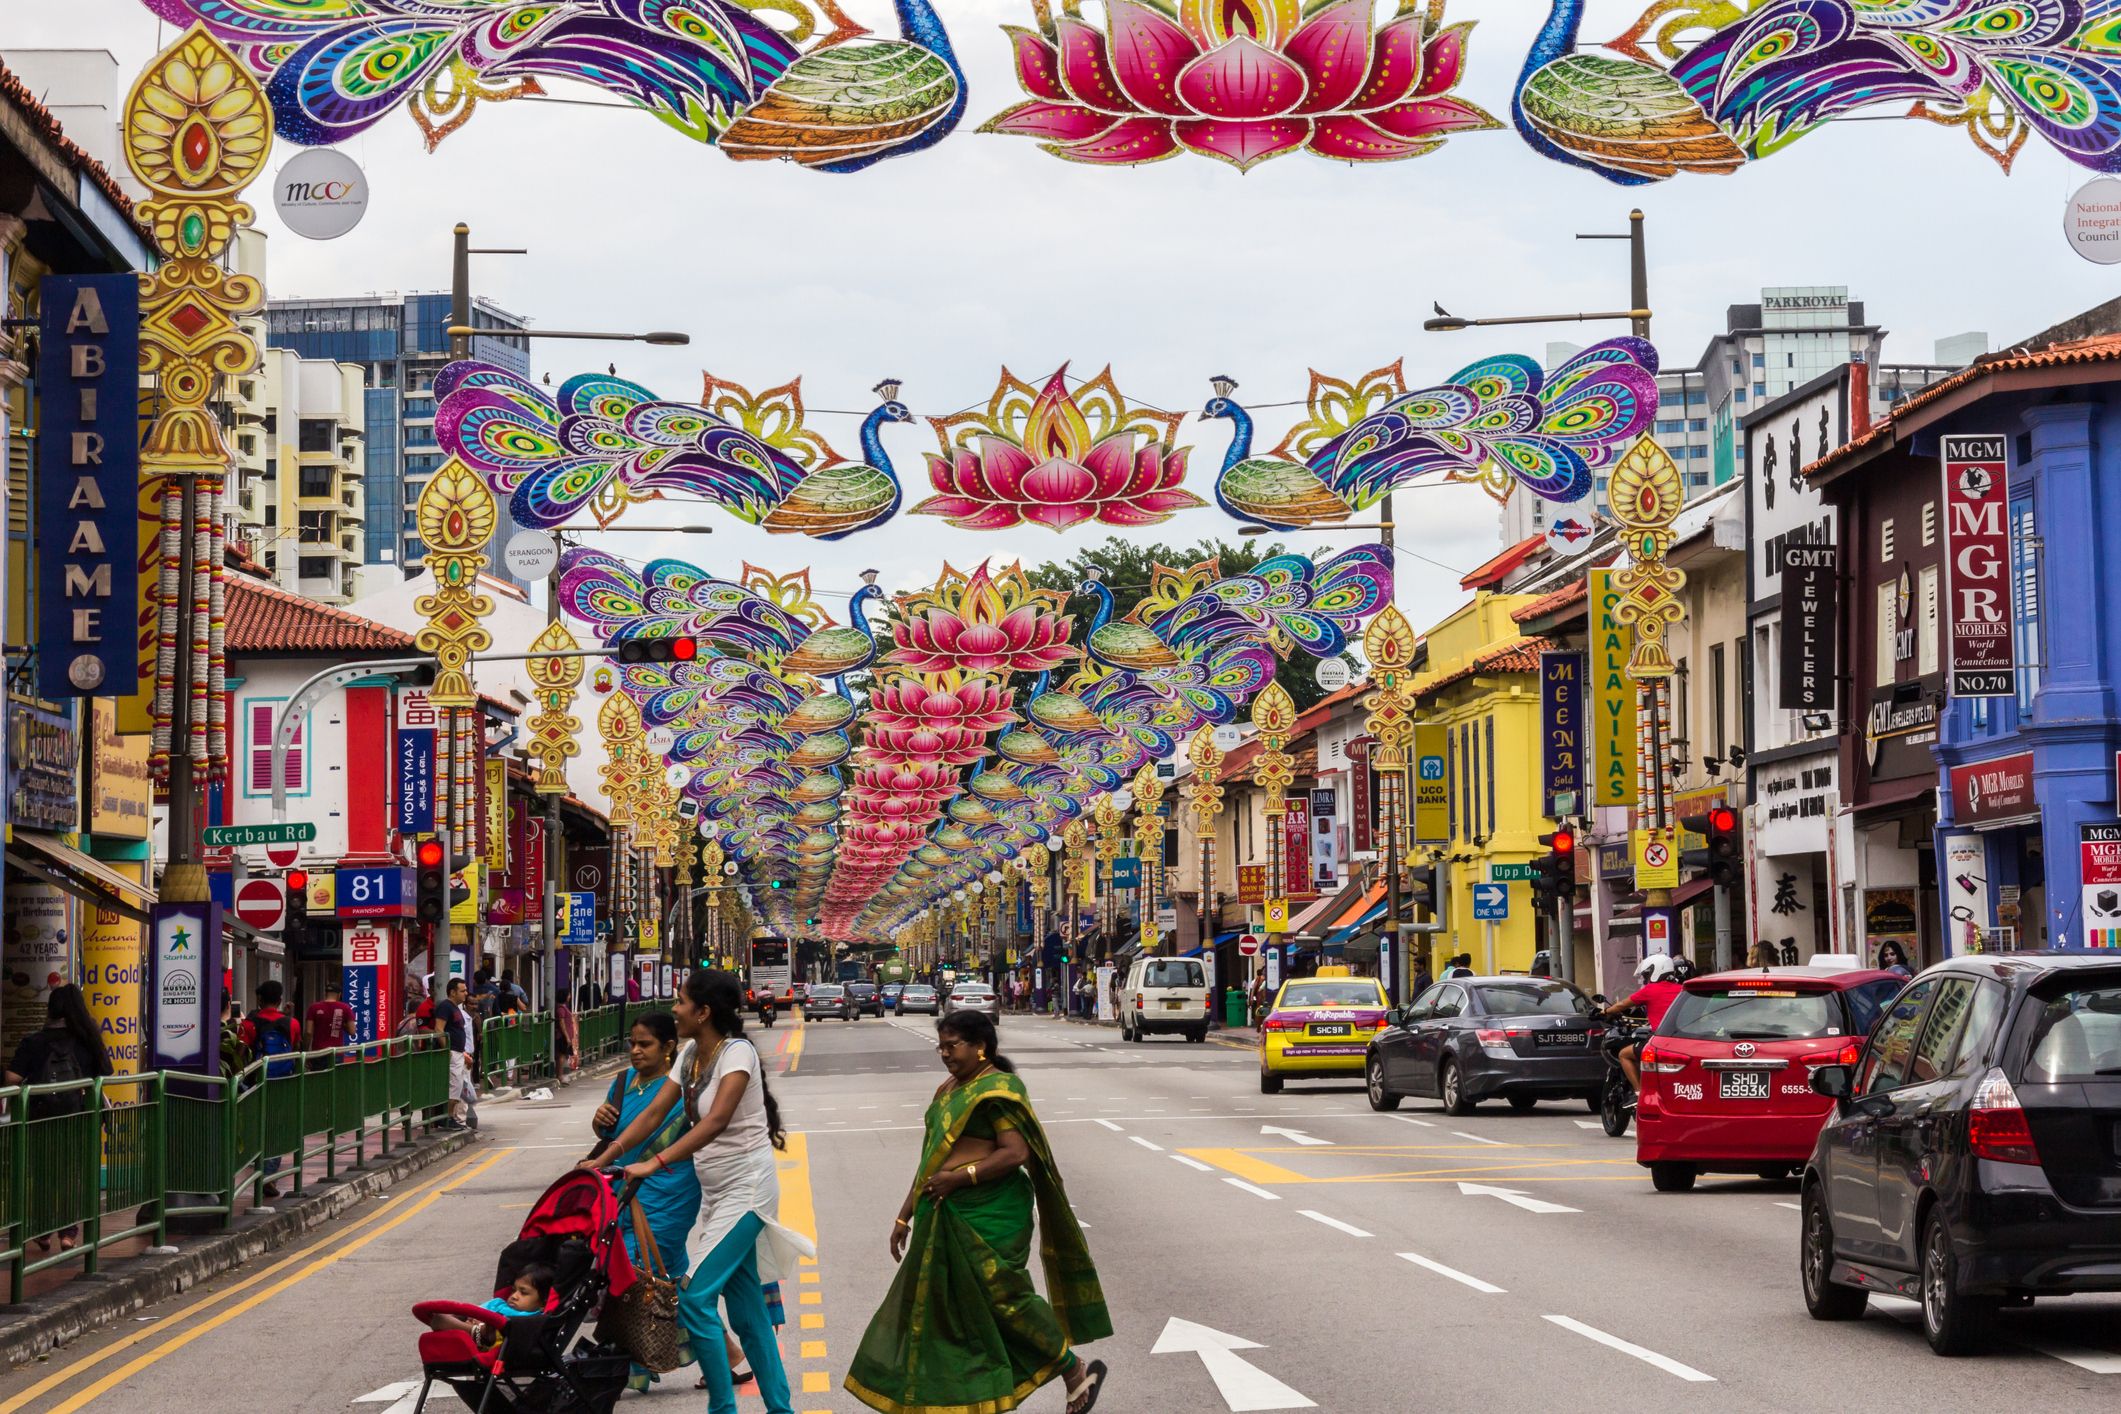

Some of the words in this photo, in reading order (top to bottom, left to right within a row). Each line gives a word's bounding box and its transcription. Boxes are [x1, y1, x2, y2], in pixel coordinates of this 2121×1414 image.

[2077, 230, 2119, 242] Council
[1765, 296, 1846, 308] PARKROYAL
[1948, 441, 2003, 459] MGM
[65, 286, 112, 642] ABIRAAME
[509, 547, 553, 557] SERANGOON
[1785, 549, 1835, 567] GMT
[518, 558, 540, 566] PLAZA
[1951, 501, 2004, 623] MGR
[1955, 623, 2007, 637] MOBILES
[1801, 571, 1819, 704] JEWELLERS
[1968, 639, 1995, 649] World
[1895, 628, 1914, 662] GMT
[1976, 649, 1986, 660] of
[1954, 657, 2010, 668] Connections
[74, 662, 100, 681] 69
[1958, 675, 2007, 691] NO.70
[1548, 663, 1577, 771] MEENA
[1873, 700, 1892, 734] GMT
[1606, 699, 1626, 798] VILAS
[404, 738, 414, 824] MONEYMAX
[1554, 774, 1574, 787] Gold
[1981, 772, 1998, 795] MGR
[1420, 786, 1444, 795] UCO
[1313, 792, 1334, 804] LIMRA
[1416, 795, 1448, 805] BANK
[1287, 811, 1307, 825] AR
[212, 826, 278, 845] Kerbau
[286, 823, 307, 840] Rd
[1495, 866, 1519, 879] Upp
[351, 874, 384, 902] 81
[352, 907, 385, 915] PAWNSHOP
[569, 907, 593, 917] ane
[1476, 908, 1491, 917] ONE
[1492, 908, 1506, 916] WAY
[572, 918, 585, 927] Sat
[575, 928, 593, 938] 11pm
[33, 942, 59, 954] YEARS
[162, 953, 197, 961] StarHub
[83, 964, 98, 985] ld
[105, 963, 139, 985] Gold
[92, 992, 121, 1007] For
[173, 997, 196, 1005] HOUR
[379, 989, 387, 1010] DAILY
[379, 1011, 387, 1032] OPEN
[1313, 1010, 1356, 1020] MyRepublic
[100, 1017, 138, 1034] ASH
[1732, 1073, 1759, 1085] SHD
[1673, 1082, 1702, 1095] TRANS
[1722, 1085, 1768, 1097] 5993K
[1686, 1092, 1703, 1101] cab
